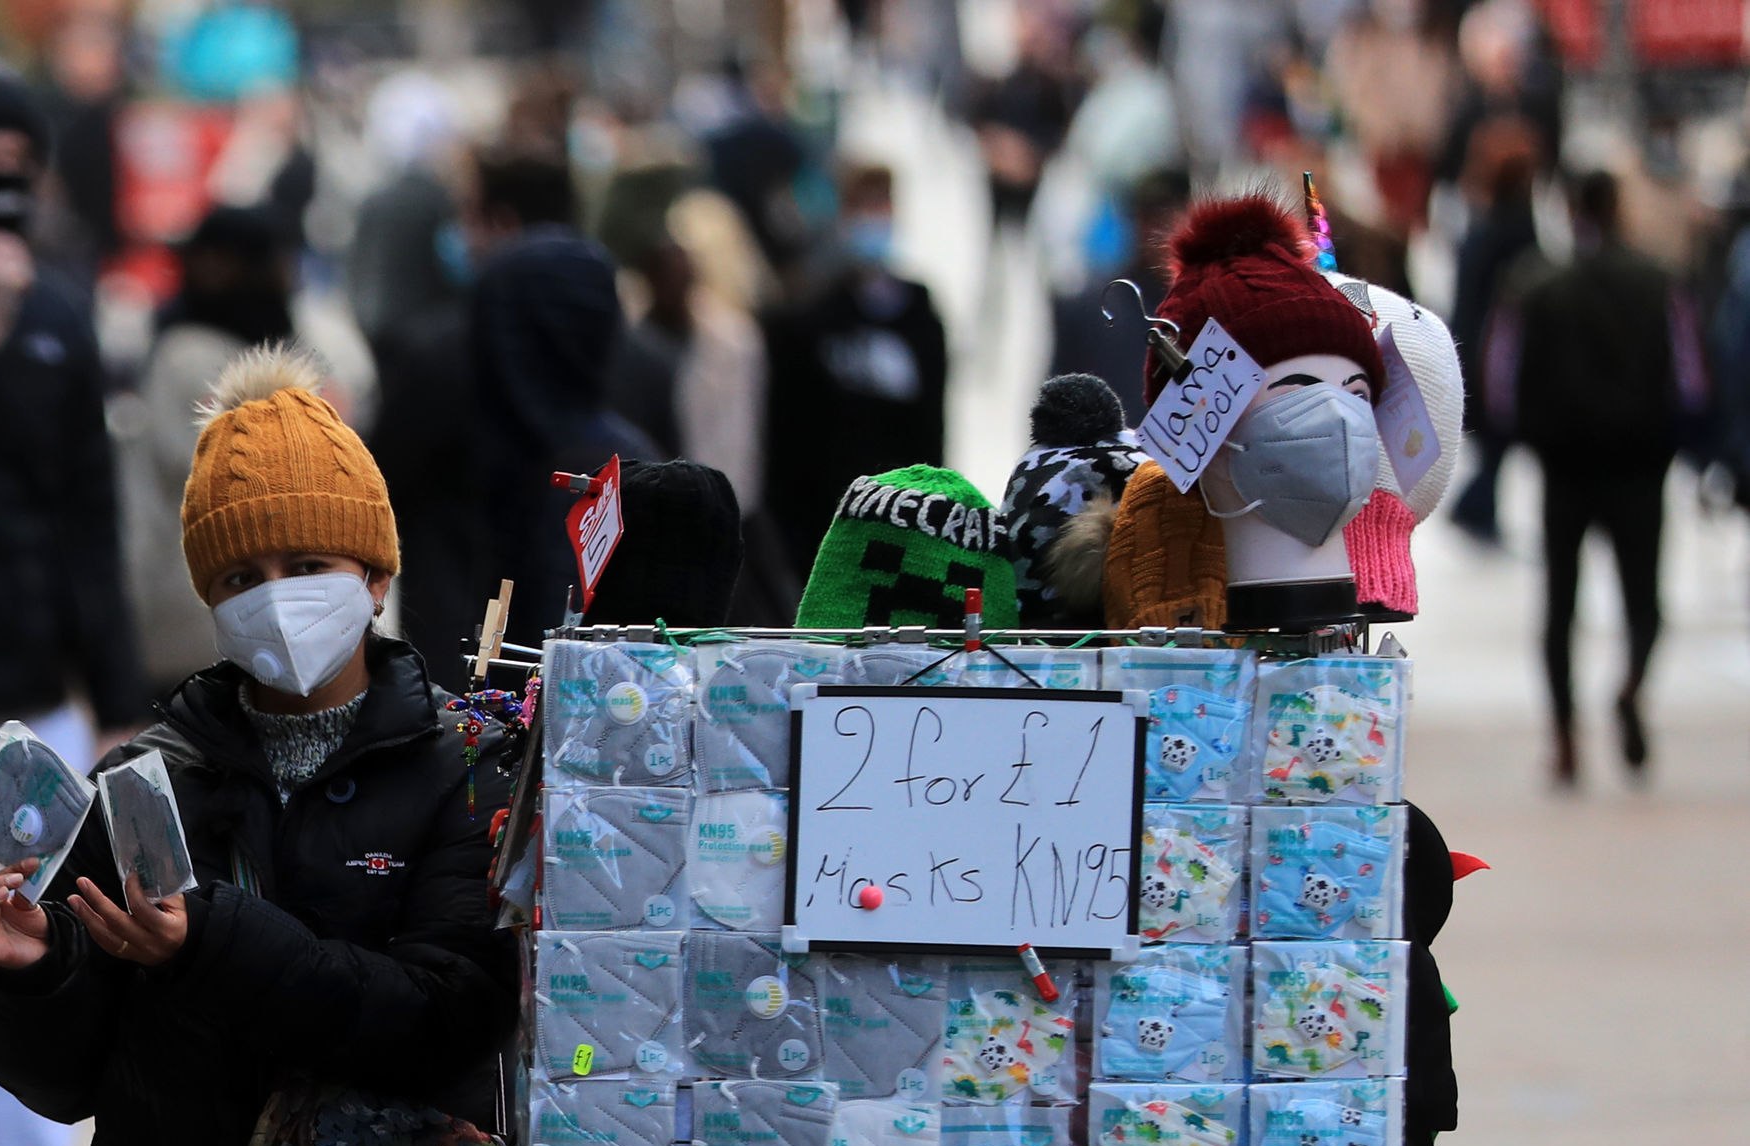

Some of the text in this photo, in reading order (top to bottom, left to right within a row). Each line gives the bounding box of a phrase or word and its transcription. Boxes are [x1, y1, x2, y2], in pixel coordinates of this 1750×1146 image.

[815, 705, 876, 811] 2
[894, 706, 985, 807] for
[699, 824, 736, 839] KN95
[1010, 823, 1131, 931] KN95
